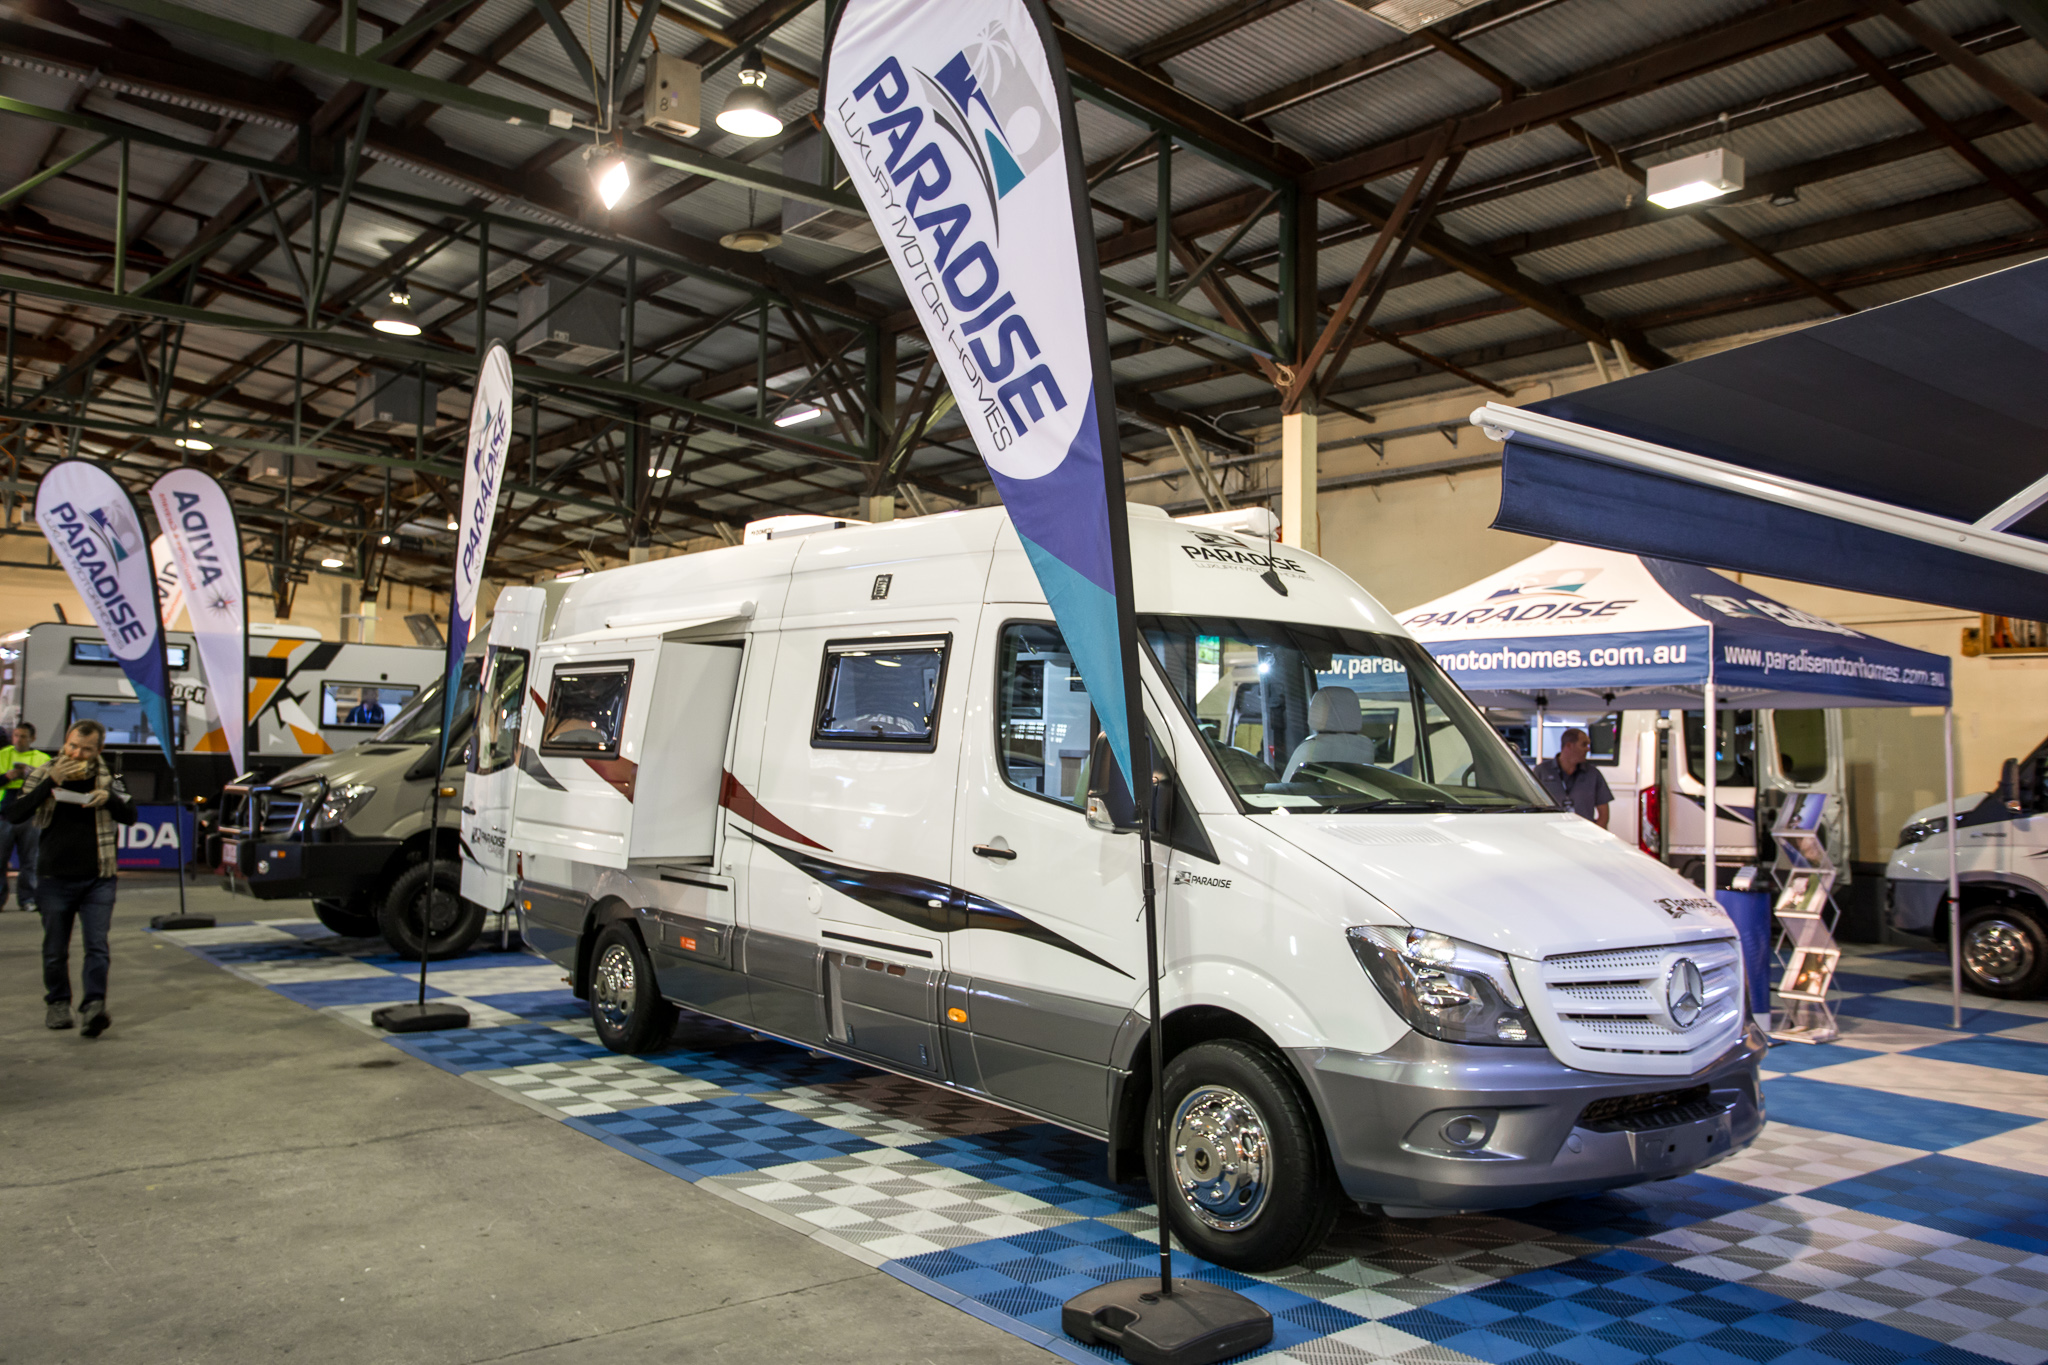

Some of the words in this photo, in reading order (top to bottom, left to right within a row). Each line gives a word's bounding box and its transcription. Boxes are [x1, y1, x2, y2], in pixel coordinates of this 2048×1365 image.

[852, 55, 1068, 438] PARADISE
[837, 97, 901, 210] LUXURY
[891, 214, 950, 332] MOTOR
[948, 329, 1013, 452] HOMES
[462, 399, 508, 585] PARADISE
[50, 501, 147, 645] PARADISE
[1181, 545, 1307, 574] PARADISE
[1401, 599, 1639, 628] PARADISE
[1723, 645, 1945, 687] www.paradisemotorhomes.com.au
[170, 682, 207, 704] OCK
[1191, 875, 1232, 889] PARADISE
